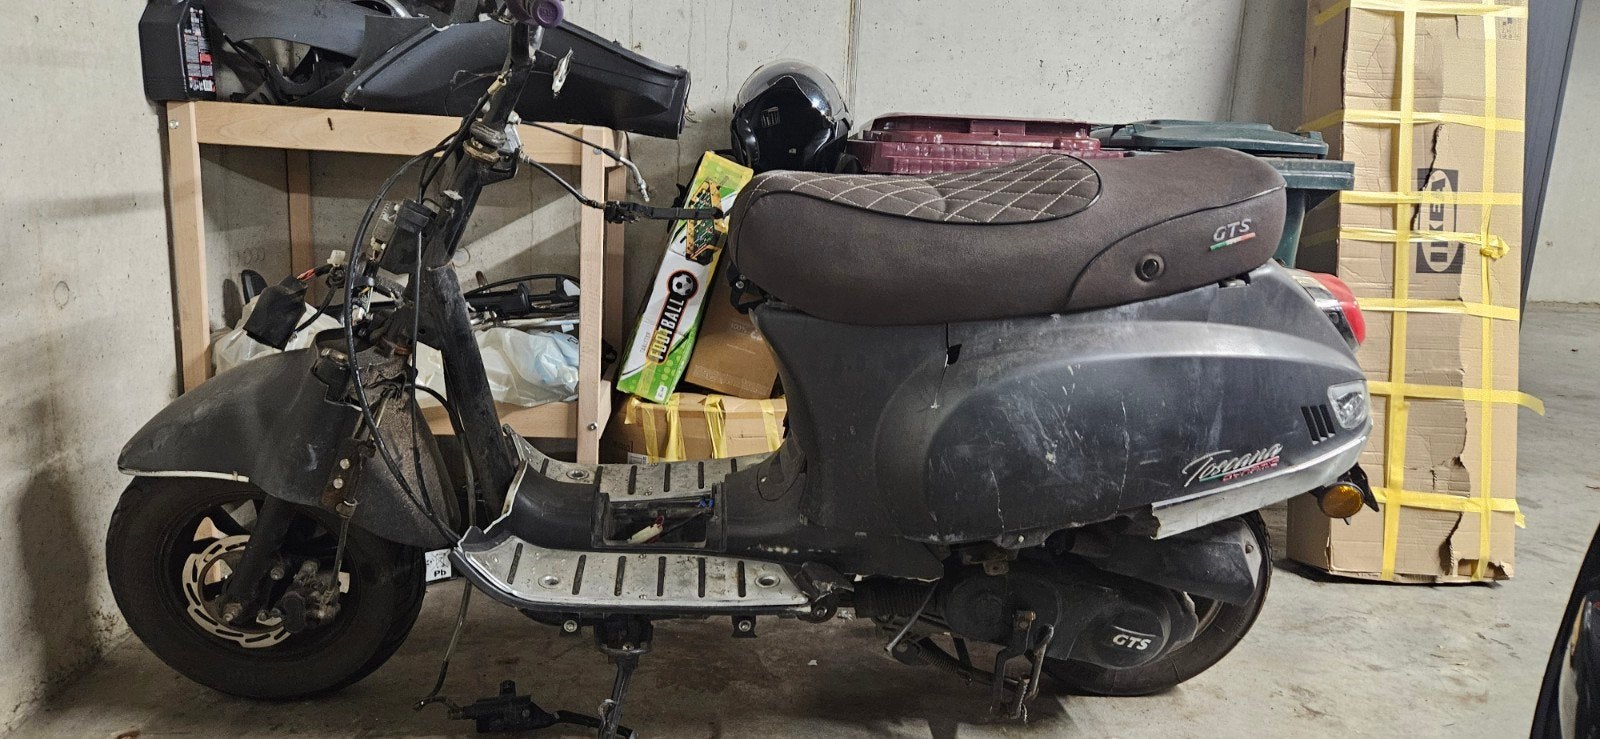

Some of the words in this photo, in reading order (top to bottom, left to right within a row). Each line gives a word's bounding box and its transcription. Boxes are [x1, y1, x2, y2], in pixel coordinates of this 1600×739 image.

[1213, 218, 1252, 242] GTS
[1428, 177, 1449, 263] IKEA
[649, 298, 685, 360] FOOTBALL
[1181, 443, 1283, 487] Toscana
[434, 569, 447, 578] Pb
[1112, 634, 1152, 650] GTS
